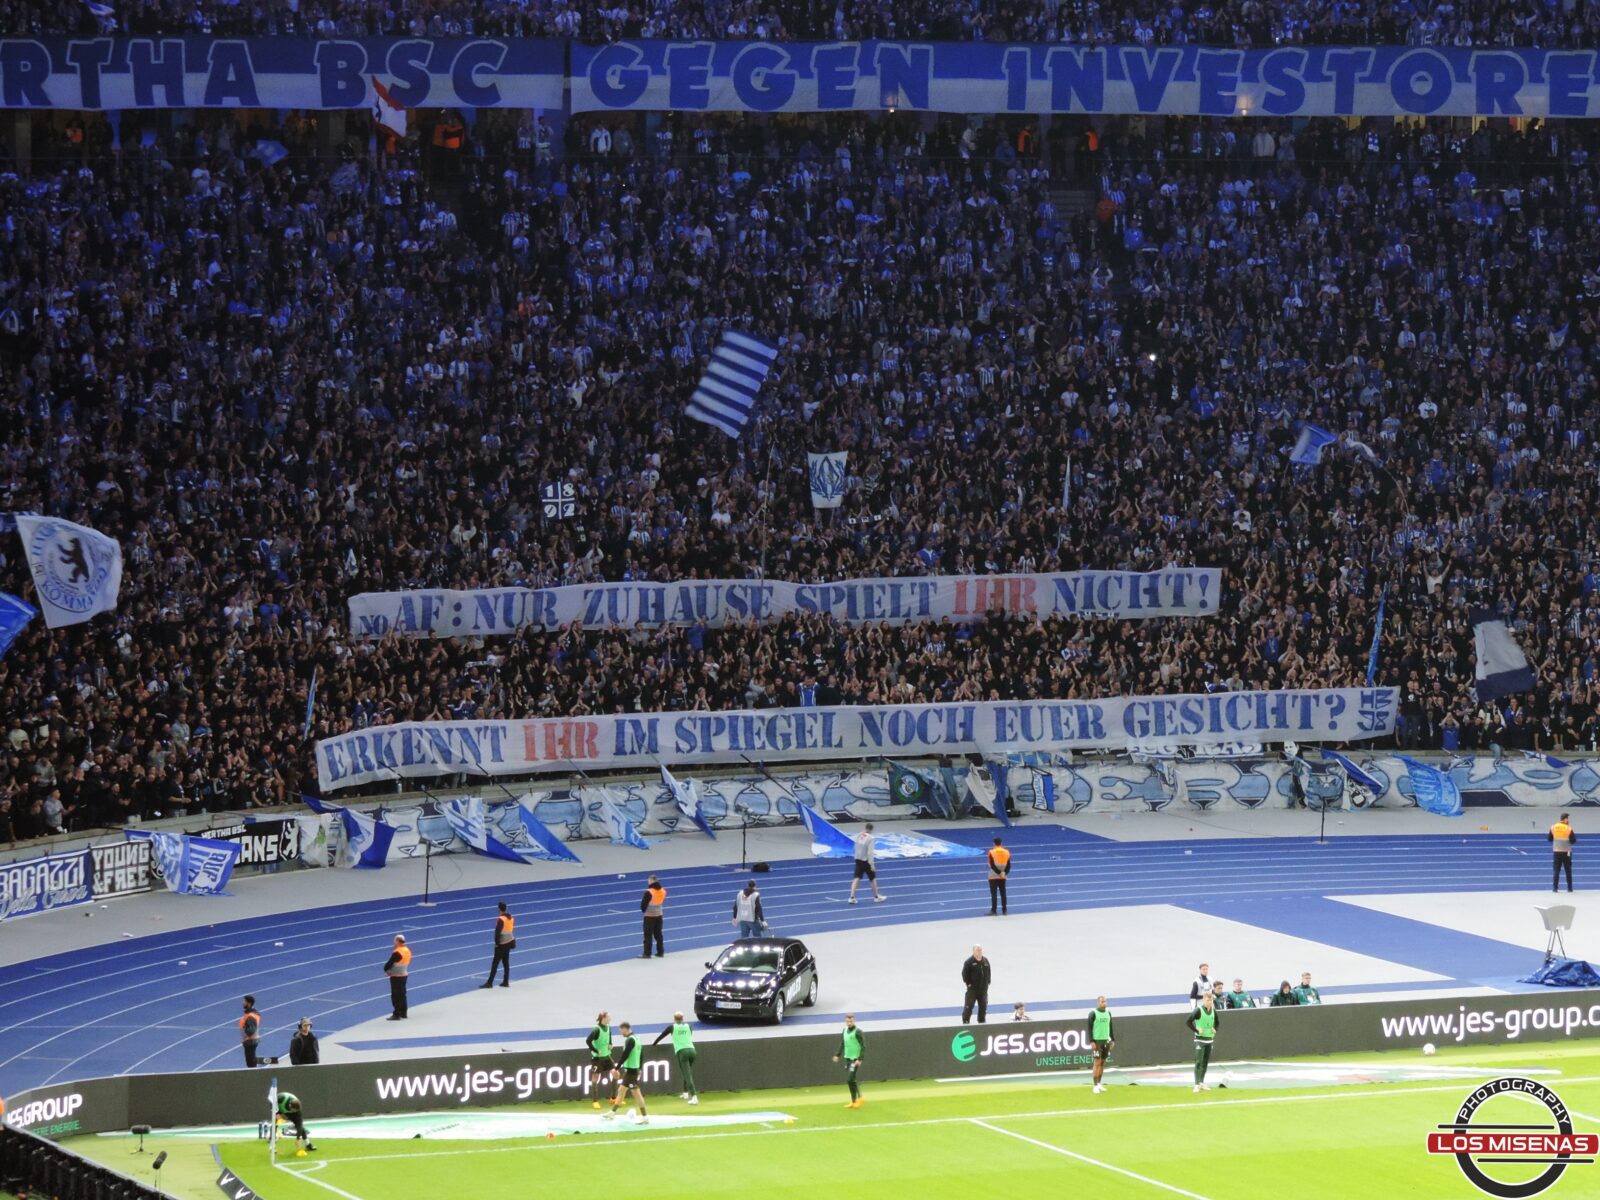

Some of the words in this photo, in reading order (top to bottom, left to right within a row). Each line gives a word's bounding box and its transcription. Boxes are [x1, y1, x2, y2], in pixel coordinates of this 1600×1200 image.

[314, 40, 508, 108] BSC
[586, 42, 934, 112] GEGEN
[1003, 47, 1597, 116] INVESTORE
[359, 613, 389, 635] NO
[583, 584, 775, 627] ZUHAUSE
[795, 581, 938, 620] SPIELT
[952, 577, 1038, 615] IHR
[1054, 573, 1210, 613] NICHT!
[324, 725, 507, 783] ERKENNT
[523, 721, 598, 762] IHR
[613, 718, 659, 756] IM
[674, 711, 843, 754] SPIEGEL
[859, 707, 976, 746] NOCH
[993, 704, 1106, 743] EUER
[1123, 693, 1346, 738] GESICHT?
[980, 1030, 1093, 1056] JES.GROU
[1035, 1056, 1071, 1067] UNSERE
[376, 1060, 670, 1102] www.jes-group.m
